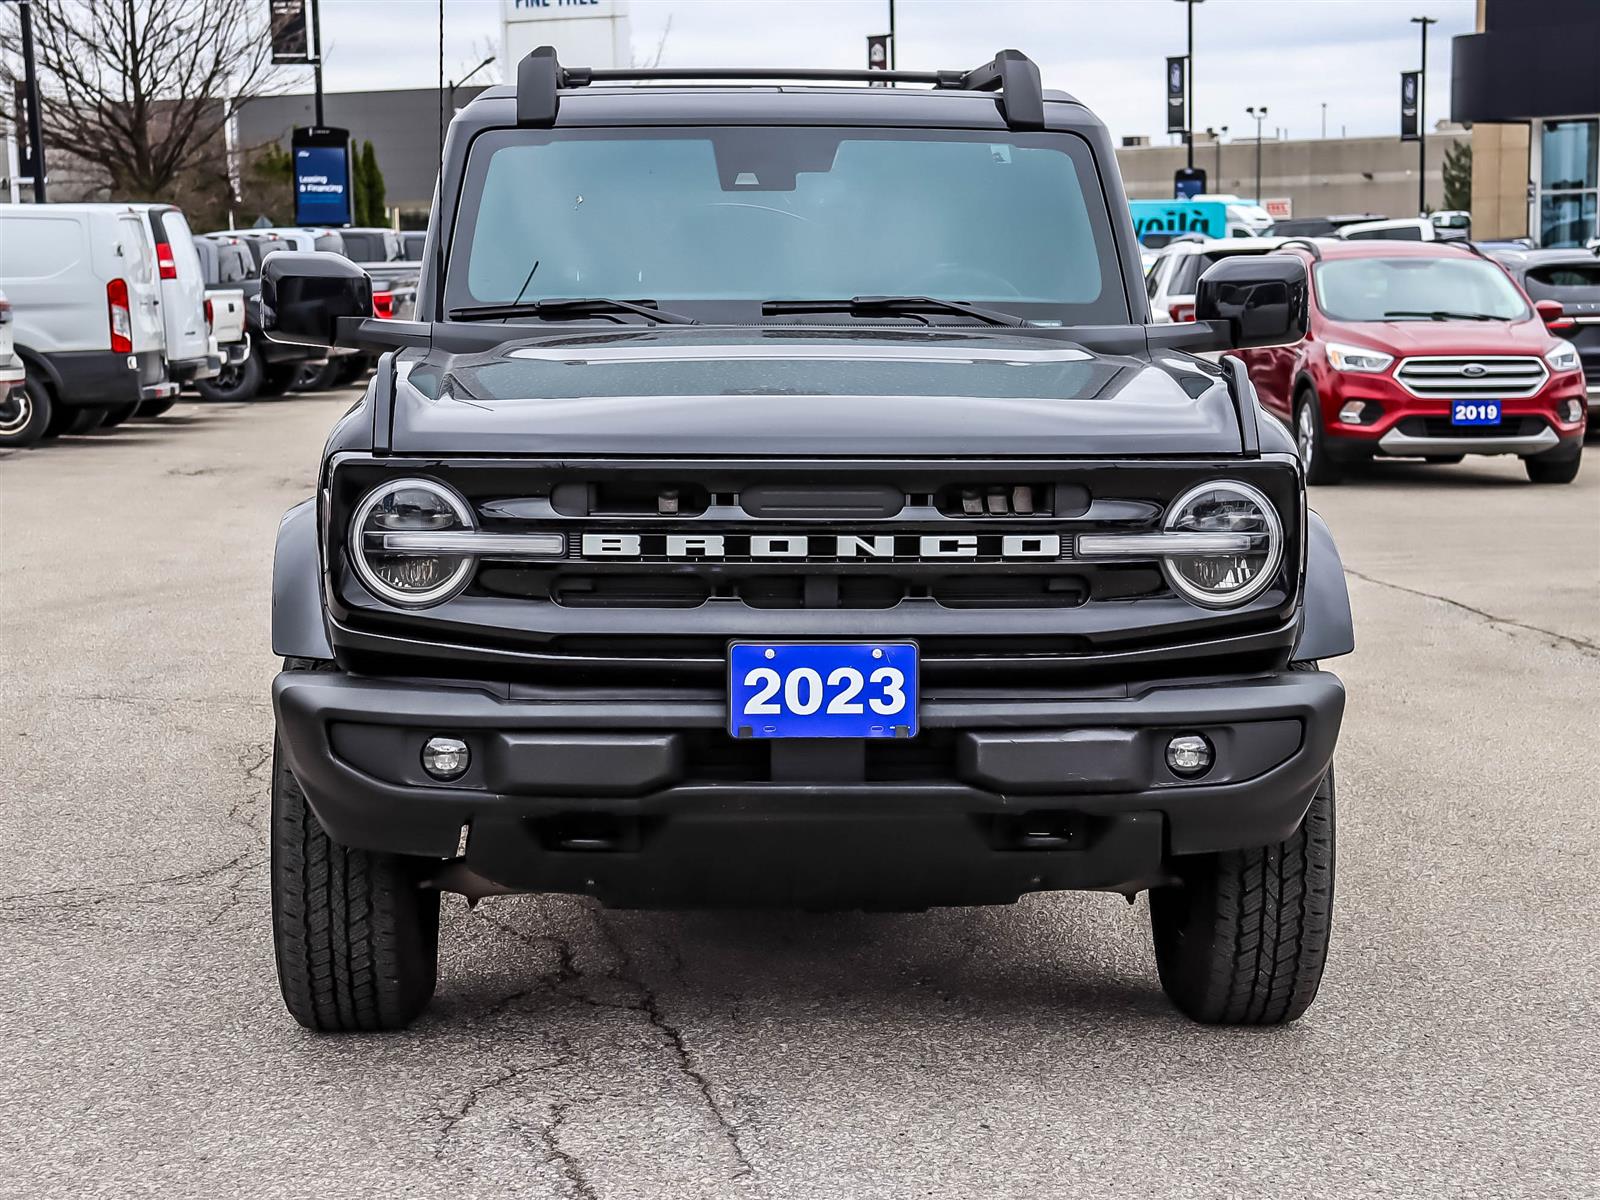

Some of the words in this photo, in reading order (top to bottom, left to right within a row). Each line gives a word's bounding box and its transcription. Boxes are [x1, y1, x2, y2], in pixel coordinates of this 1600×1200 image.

[307, 184, 343, 194] Financing
[1455, 405, 1498, 420] 2019
[581, 534, 1061, 558] BRONCO
[743, 667, 906, 715] 2023
